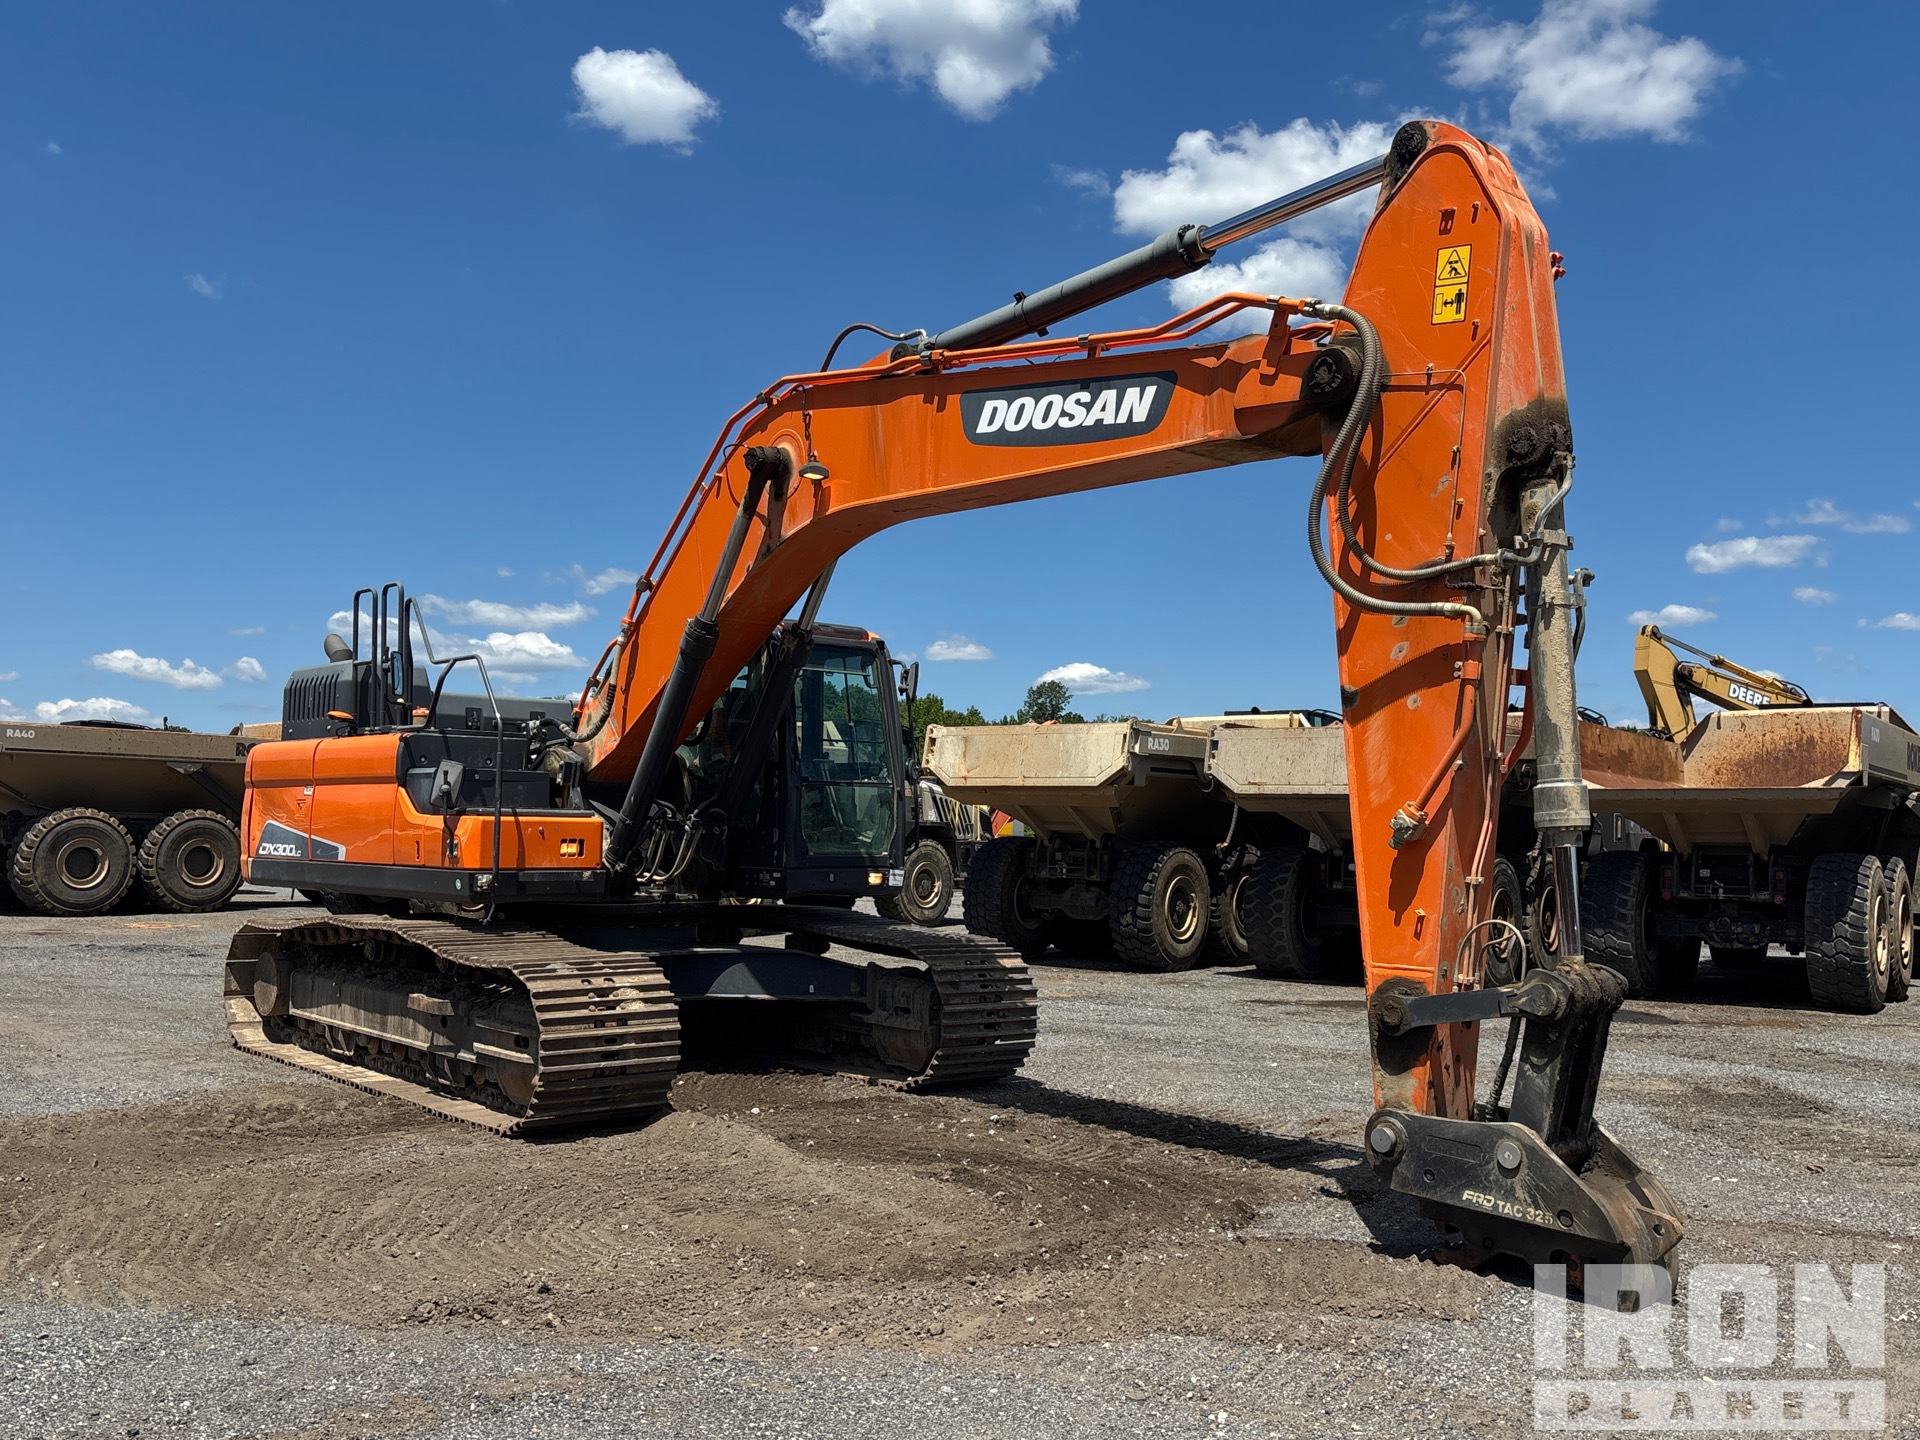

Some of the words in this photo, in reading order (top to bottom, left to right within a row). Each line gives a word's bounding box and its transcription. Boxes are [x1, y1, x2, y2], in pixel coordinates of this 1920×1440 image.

[975, 385, 1158, 434] DOOSAN
[1728, 682, 1771, 706] DEERE
[6, 728, 36, 739] RA40
[1147, 737, 1170, 752] RA30
[1462, 1189, 1495, 1208] FRD
[1496, 1200, 1523, 1218] TAC
